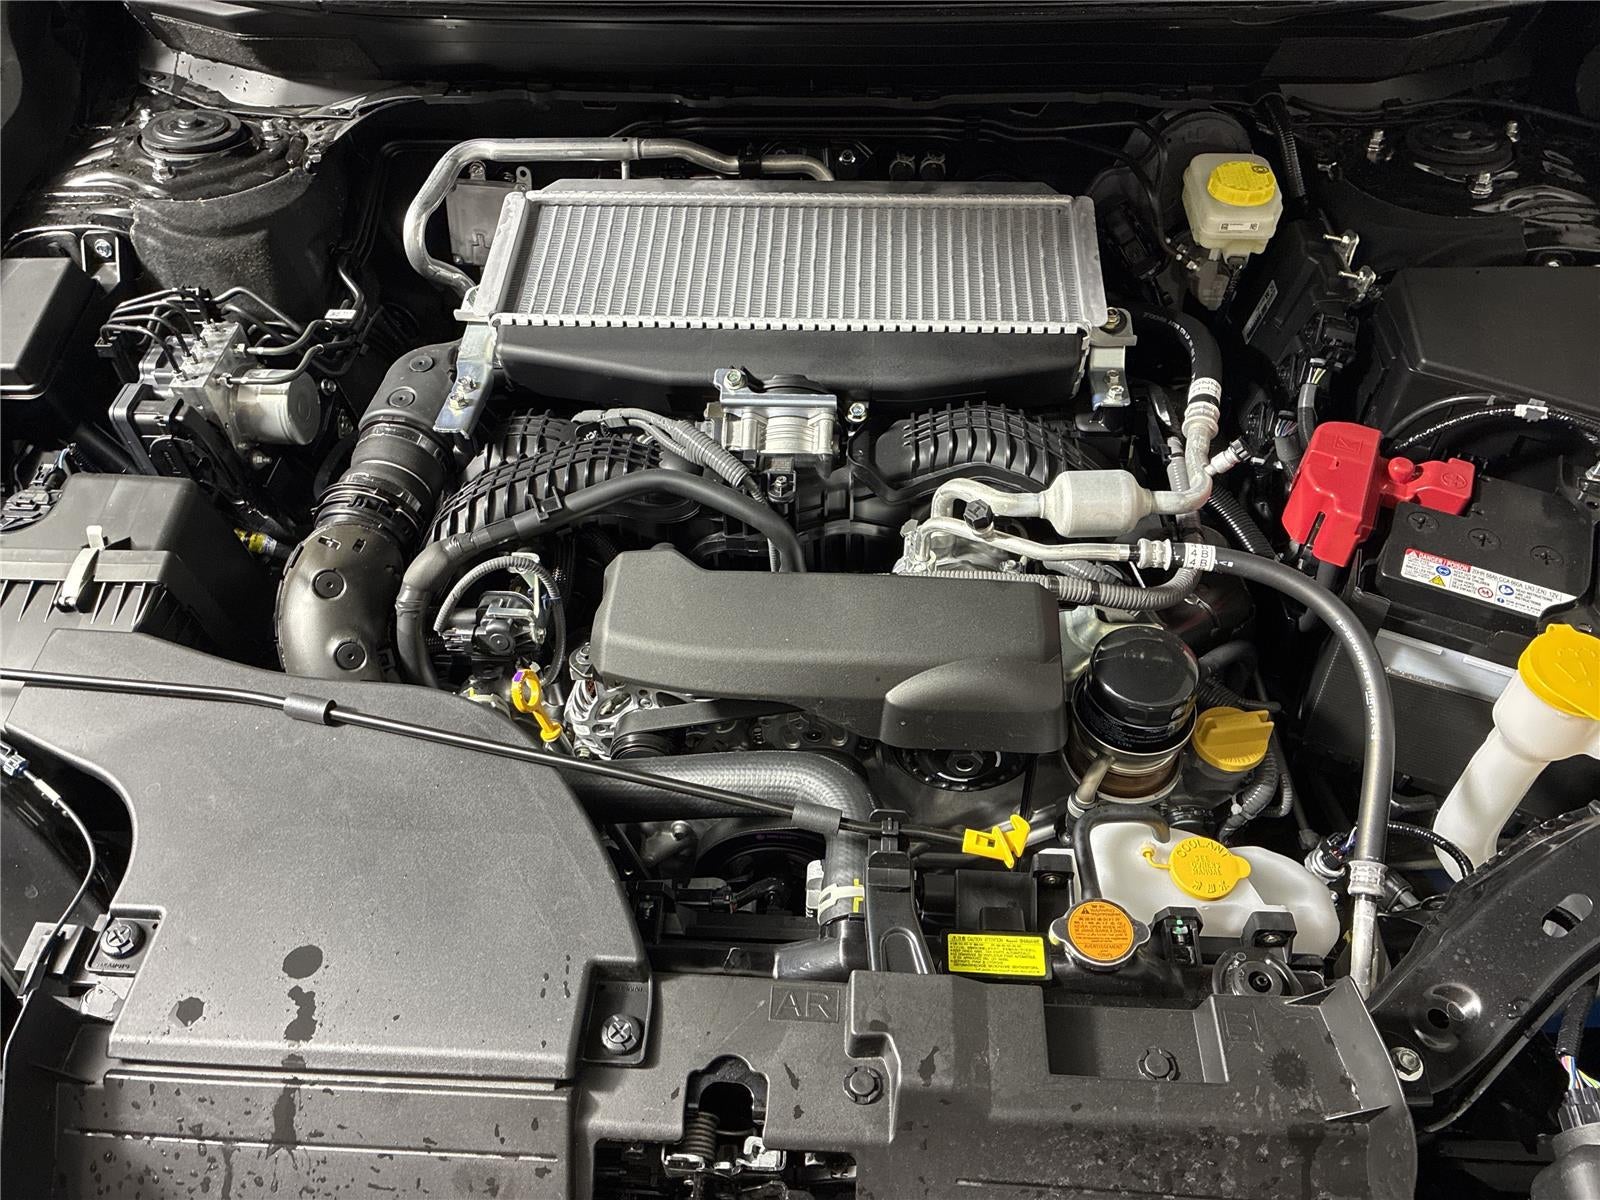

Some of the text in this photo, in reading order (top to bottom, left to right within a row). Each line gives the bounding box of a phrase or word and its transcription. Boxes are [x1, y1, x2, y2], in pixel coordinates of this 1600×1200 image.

[1419, 552, 1444, 565] DANGER
[1447, 559, 1470, 572] POISON
[1176, 839, 1232, 858] COOLANT
[774, 991, 829, 1019] AR
